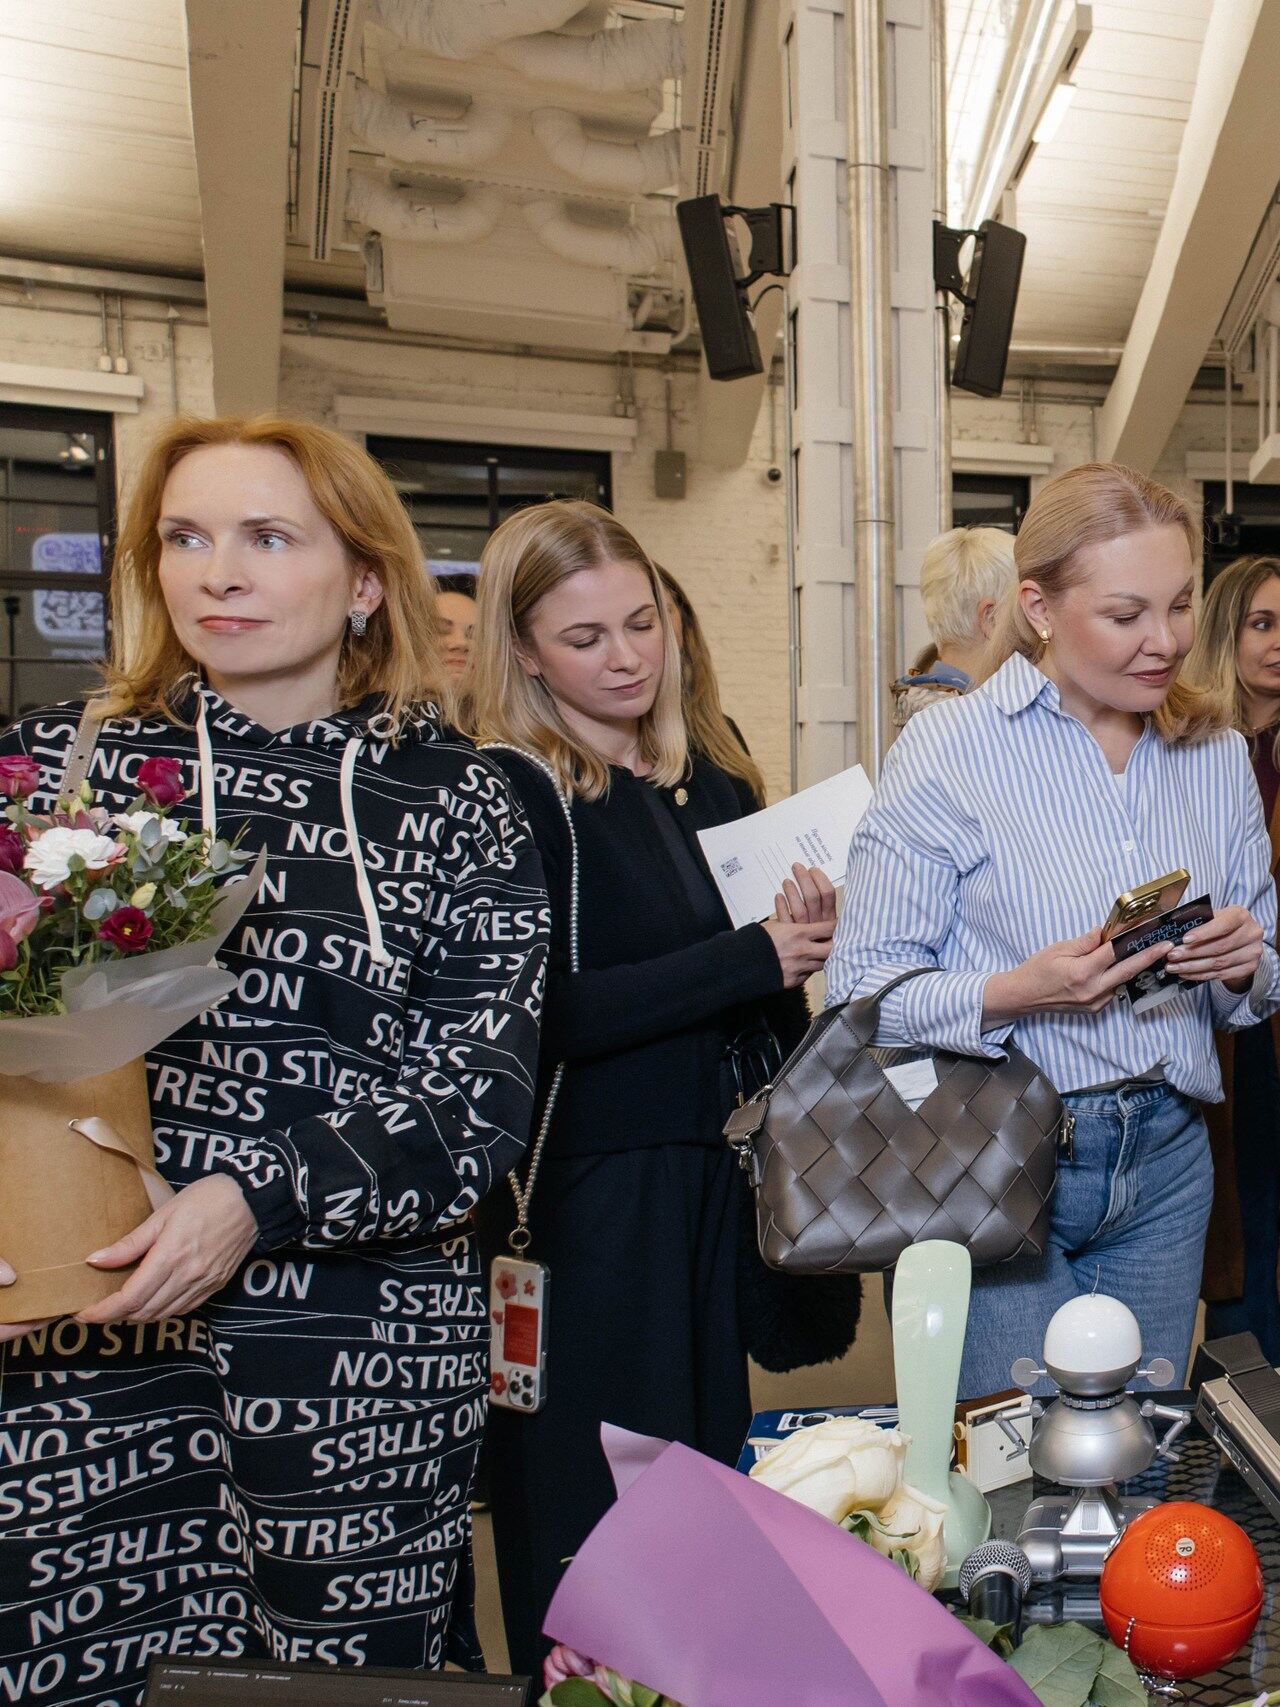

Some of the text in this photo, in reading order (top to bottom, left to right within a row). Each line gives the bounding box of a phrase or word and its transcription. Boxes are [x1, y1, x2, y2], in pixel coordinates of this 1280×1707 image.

[176, 757, 313, 809] TRESS
[286, 821, 351, 857] NO
[240, 926, 308, 964] NO
[200, 1041, 269, 1079] NO
[330, 1350, 395, 1388] NO
[224, 1391, 282, 1434] NO
[312, 1412, 445, 1477] STRESS
[29, 1518, 208, 1588] STRESS
[254, 1505, 395, 1556] STRESS
[322, 1560, 445, 1612] STRESS
[29, 1584, 104, 1646] NO
[0, 1623, 249, 1702] NO STRESS
